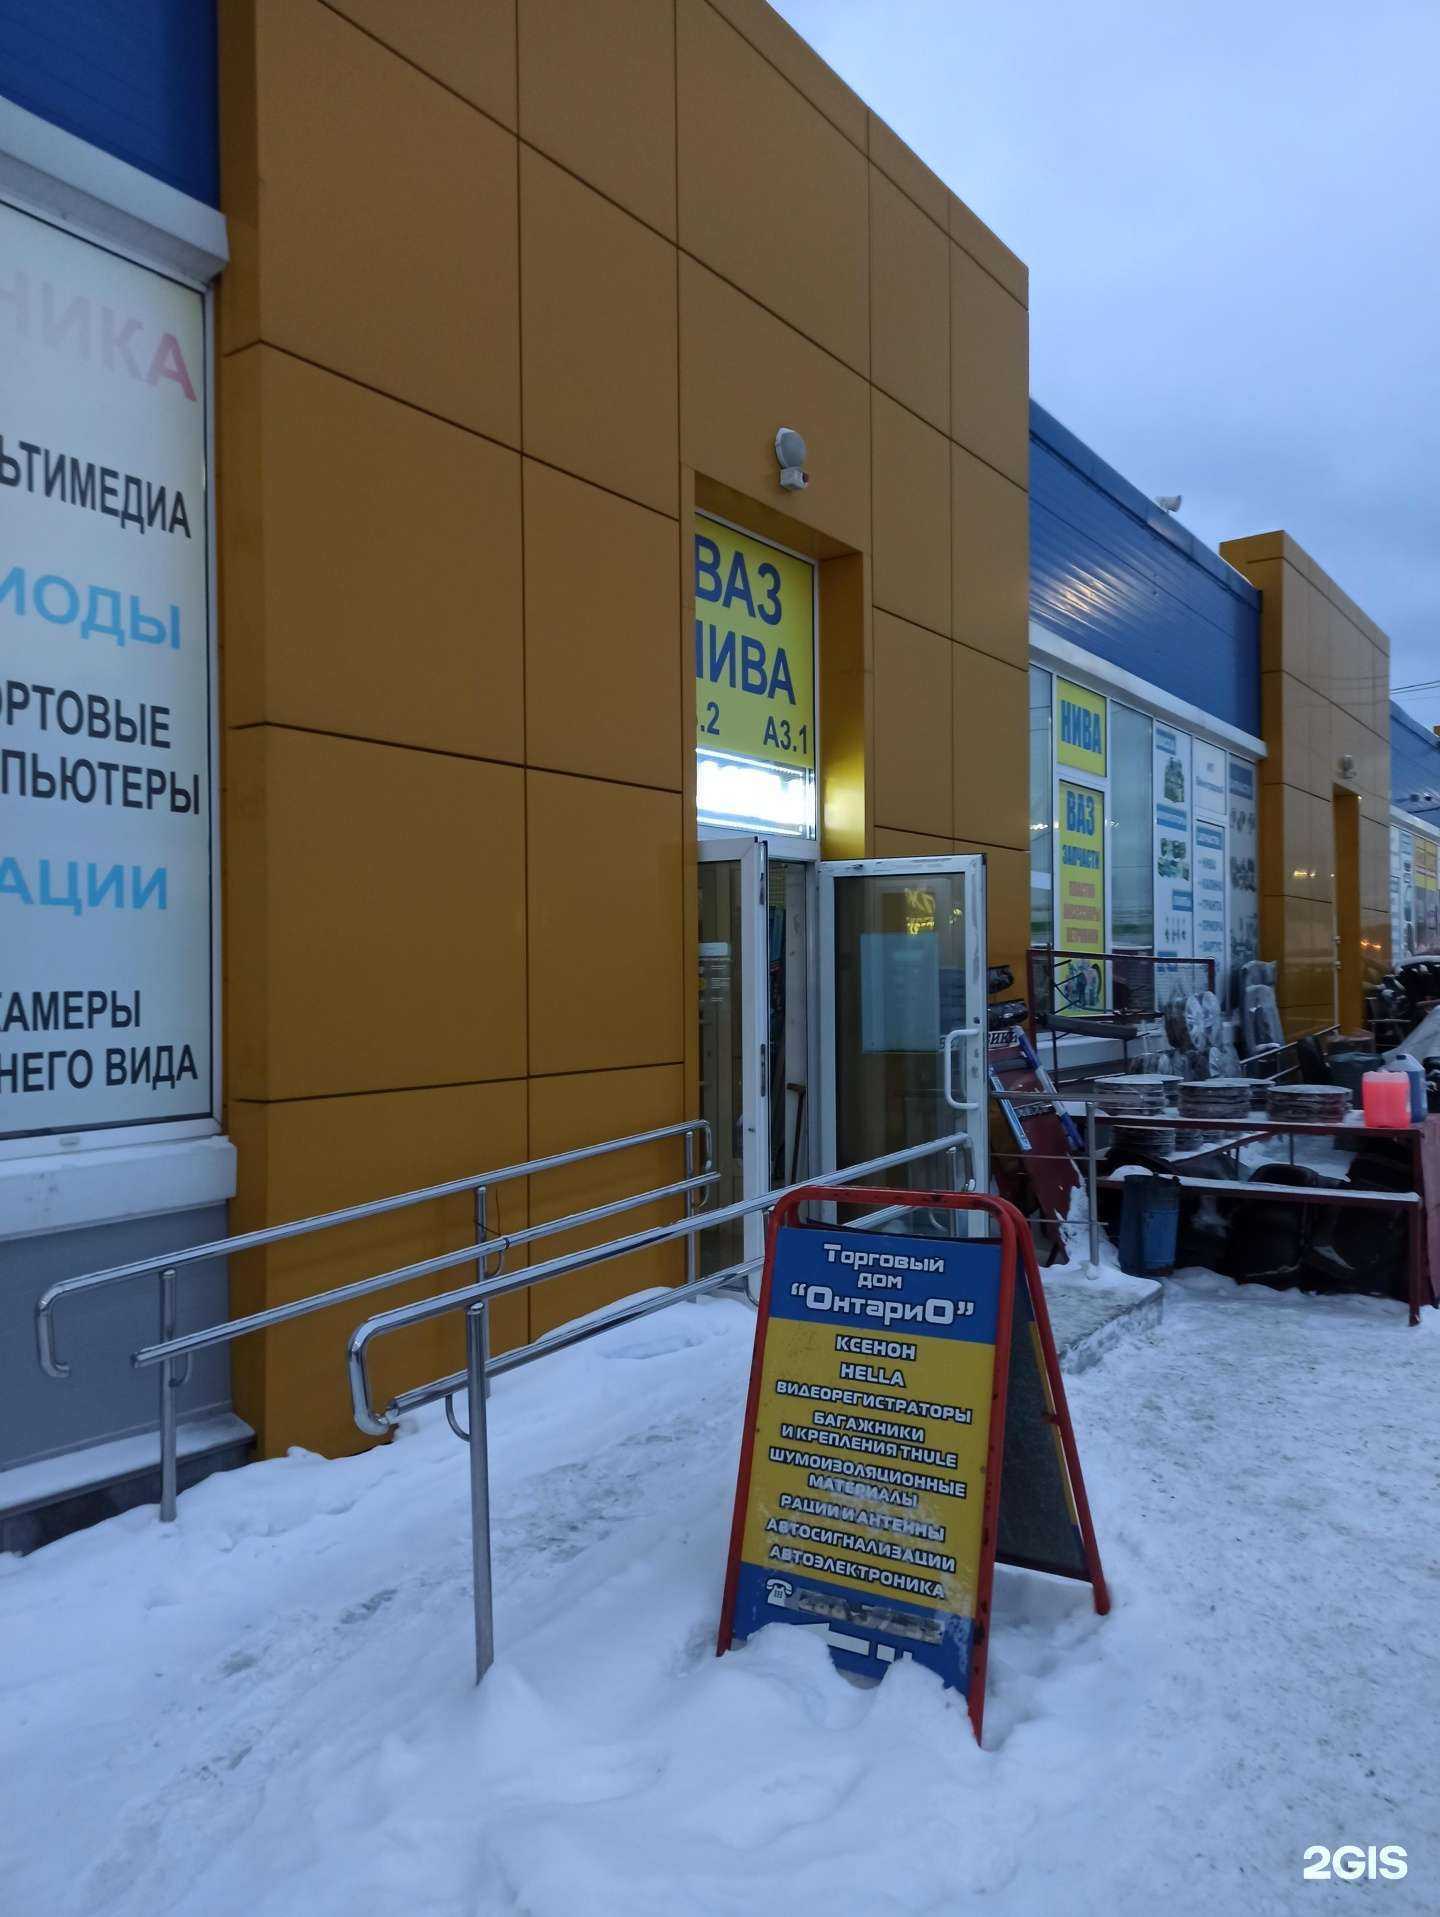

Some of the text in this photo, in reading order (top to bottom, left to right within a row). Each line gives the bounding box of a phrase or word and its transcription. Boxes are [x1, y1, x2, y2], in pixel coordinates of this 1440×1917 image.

[695, 533, 783, 626] ВАЗ
[0, 680, 172, 749] РТОВЫЕ
[1061, 698, 1103, 754] НИВА
[1065, 789, 1096, 837] ВАЗ
[0, 989, 141, 1032] АМЕРЫ
[104, 1043, 198, 1091] ВИДА
[823, 1243, 945, 1272] Торговый
[835, 1334, 917, 1361] КСЕНОН
[839, 1362, 906, 1388] HELLA
[775, 1380, 973, 1425] ВИДЕОРЕГИСТРАТОРЫ
[781, 1424, 958, 1469] И КРЕПЛЕНИЯ THULE
[813, 1411, 925, 1443] БАГАЖНИКИ
[768, 1447, 968, 1499] ШУМОИЗОЛЯЦИОННЫЕ
[808, 1473, 919, 1508] МАТЕРИАЛЫ
[780, 1494, 841, 1520] РАЦИИ
[855, 1510, 946, 1543] АНТЕННЫ
[765, 1518, 956, 1574] АВТОСИГНАЛИЗАЦИИ
[768, 1544, 946, 1600] АВТОЭЛЕКТРОНИКА
